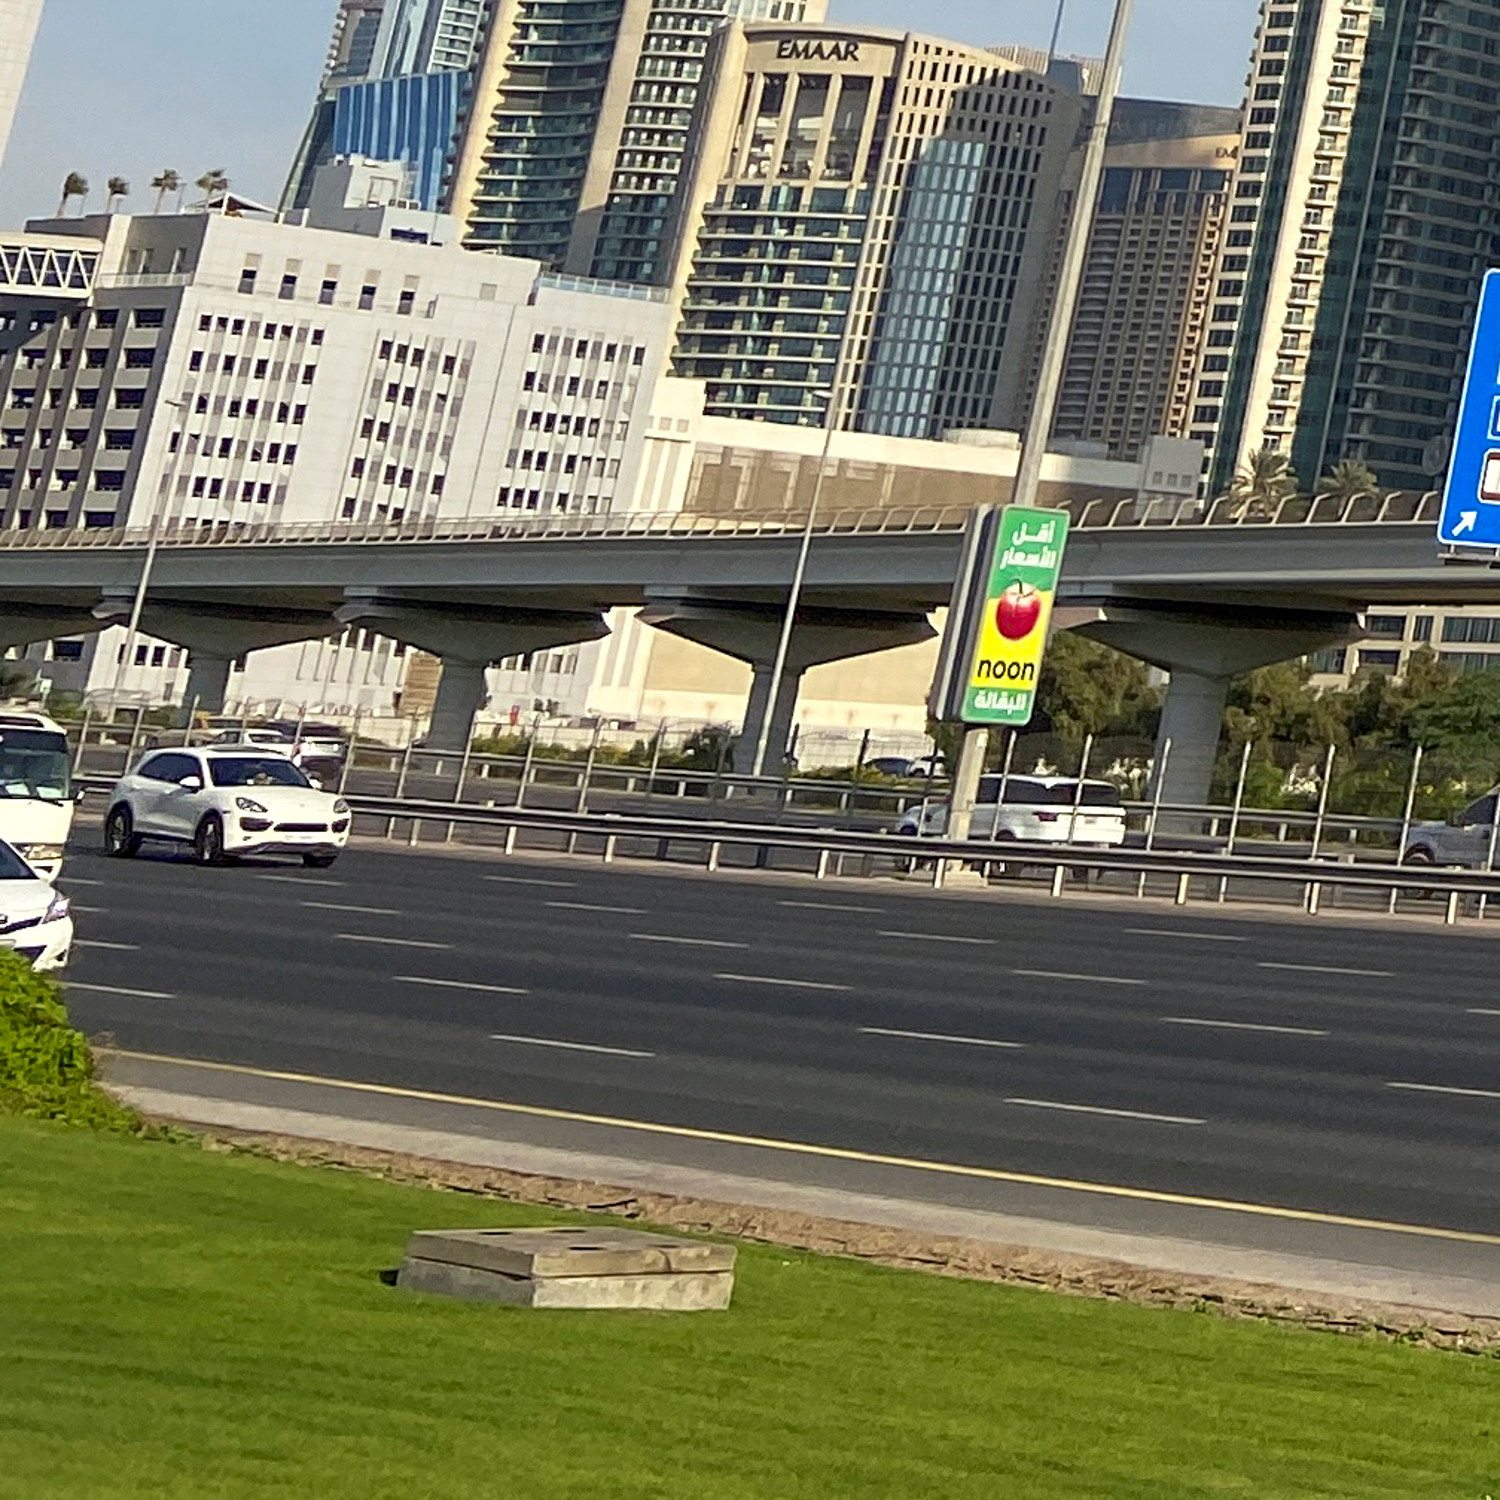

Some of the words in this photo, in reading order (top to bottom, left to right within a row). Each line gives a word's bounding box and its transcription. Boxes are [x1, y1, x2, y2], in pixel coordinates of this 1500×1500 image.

[776, 40, 859, 61] EMAAR
[1000, 546, 1056, 570] الأسعار
[976, 658, 1035, 681] noon
[974, 688, 1027, 714] البقالة
